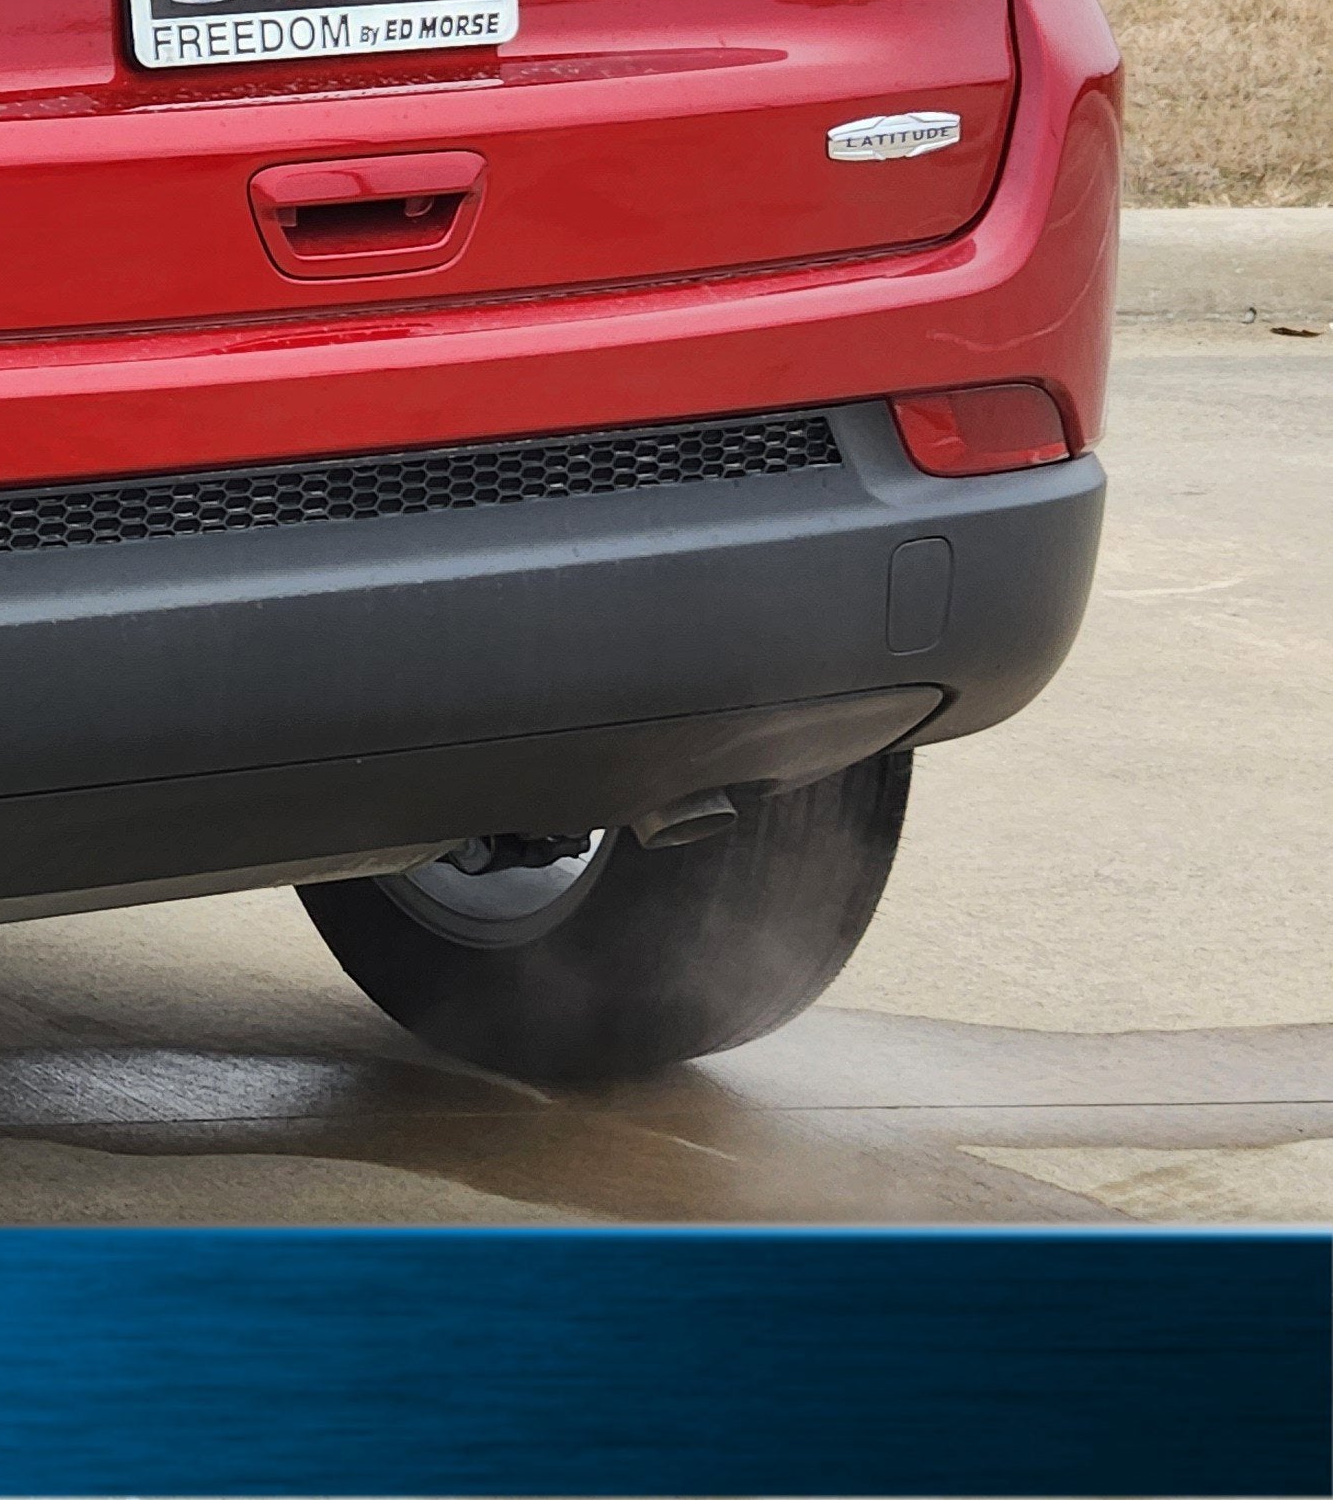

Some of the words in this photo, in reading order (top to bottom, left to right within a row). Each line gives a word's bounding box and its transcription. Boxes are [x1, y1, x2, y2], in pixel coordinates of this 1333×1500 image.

[152, 13, 351, 61] FREEDOM
[384, 19, 414, 41] ED
[418, 12, 500, 40] MORSE
[846, 126, 951, 148] LATITUDE
